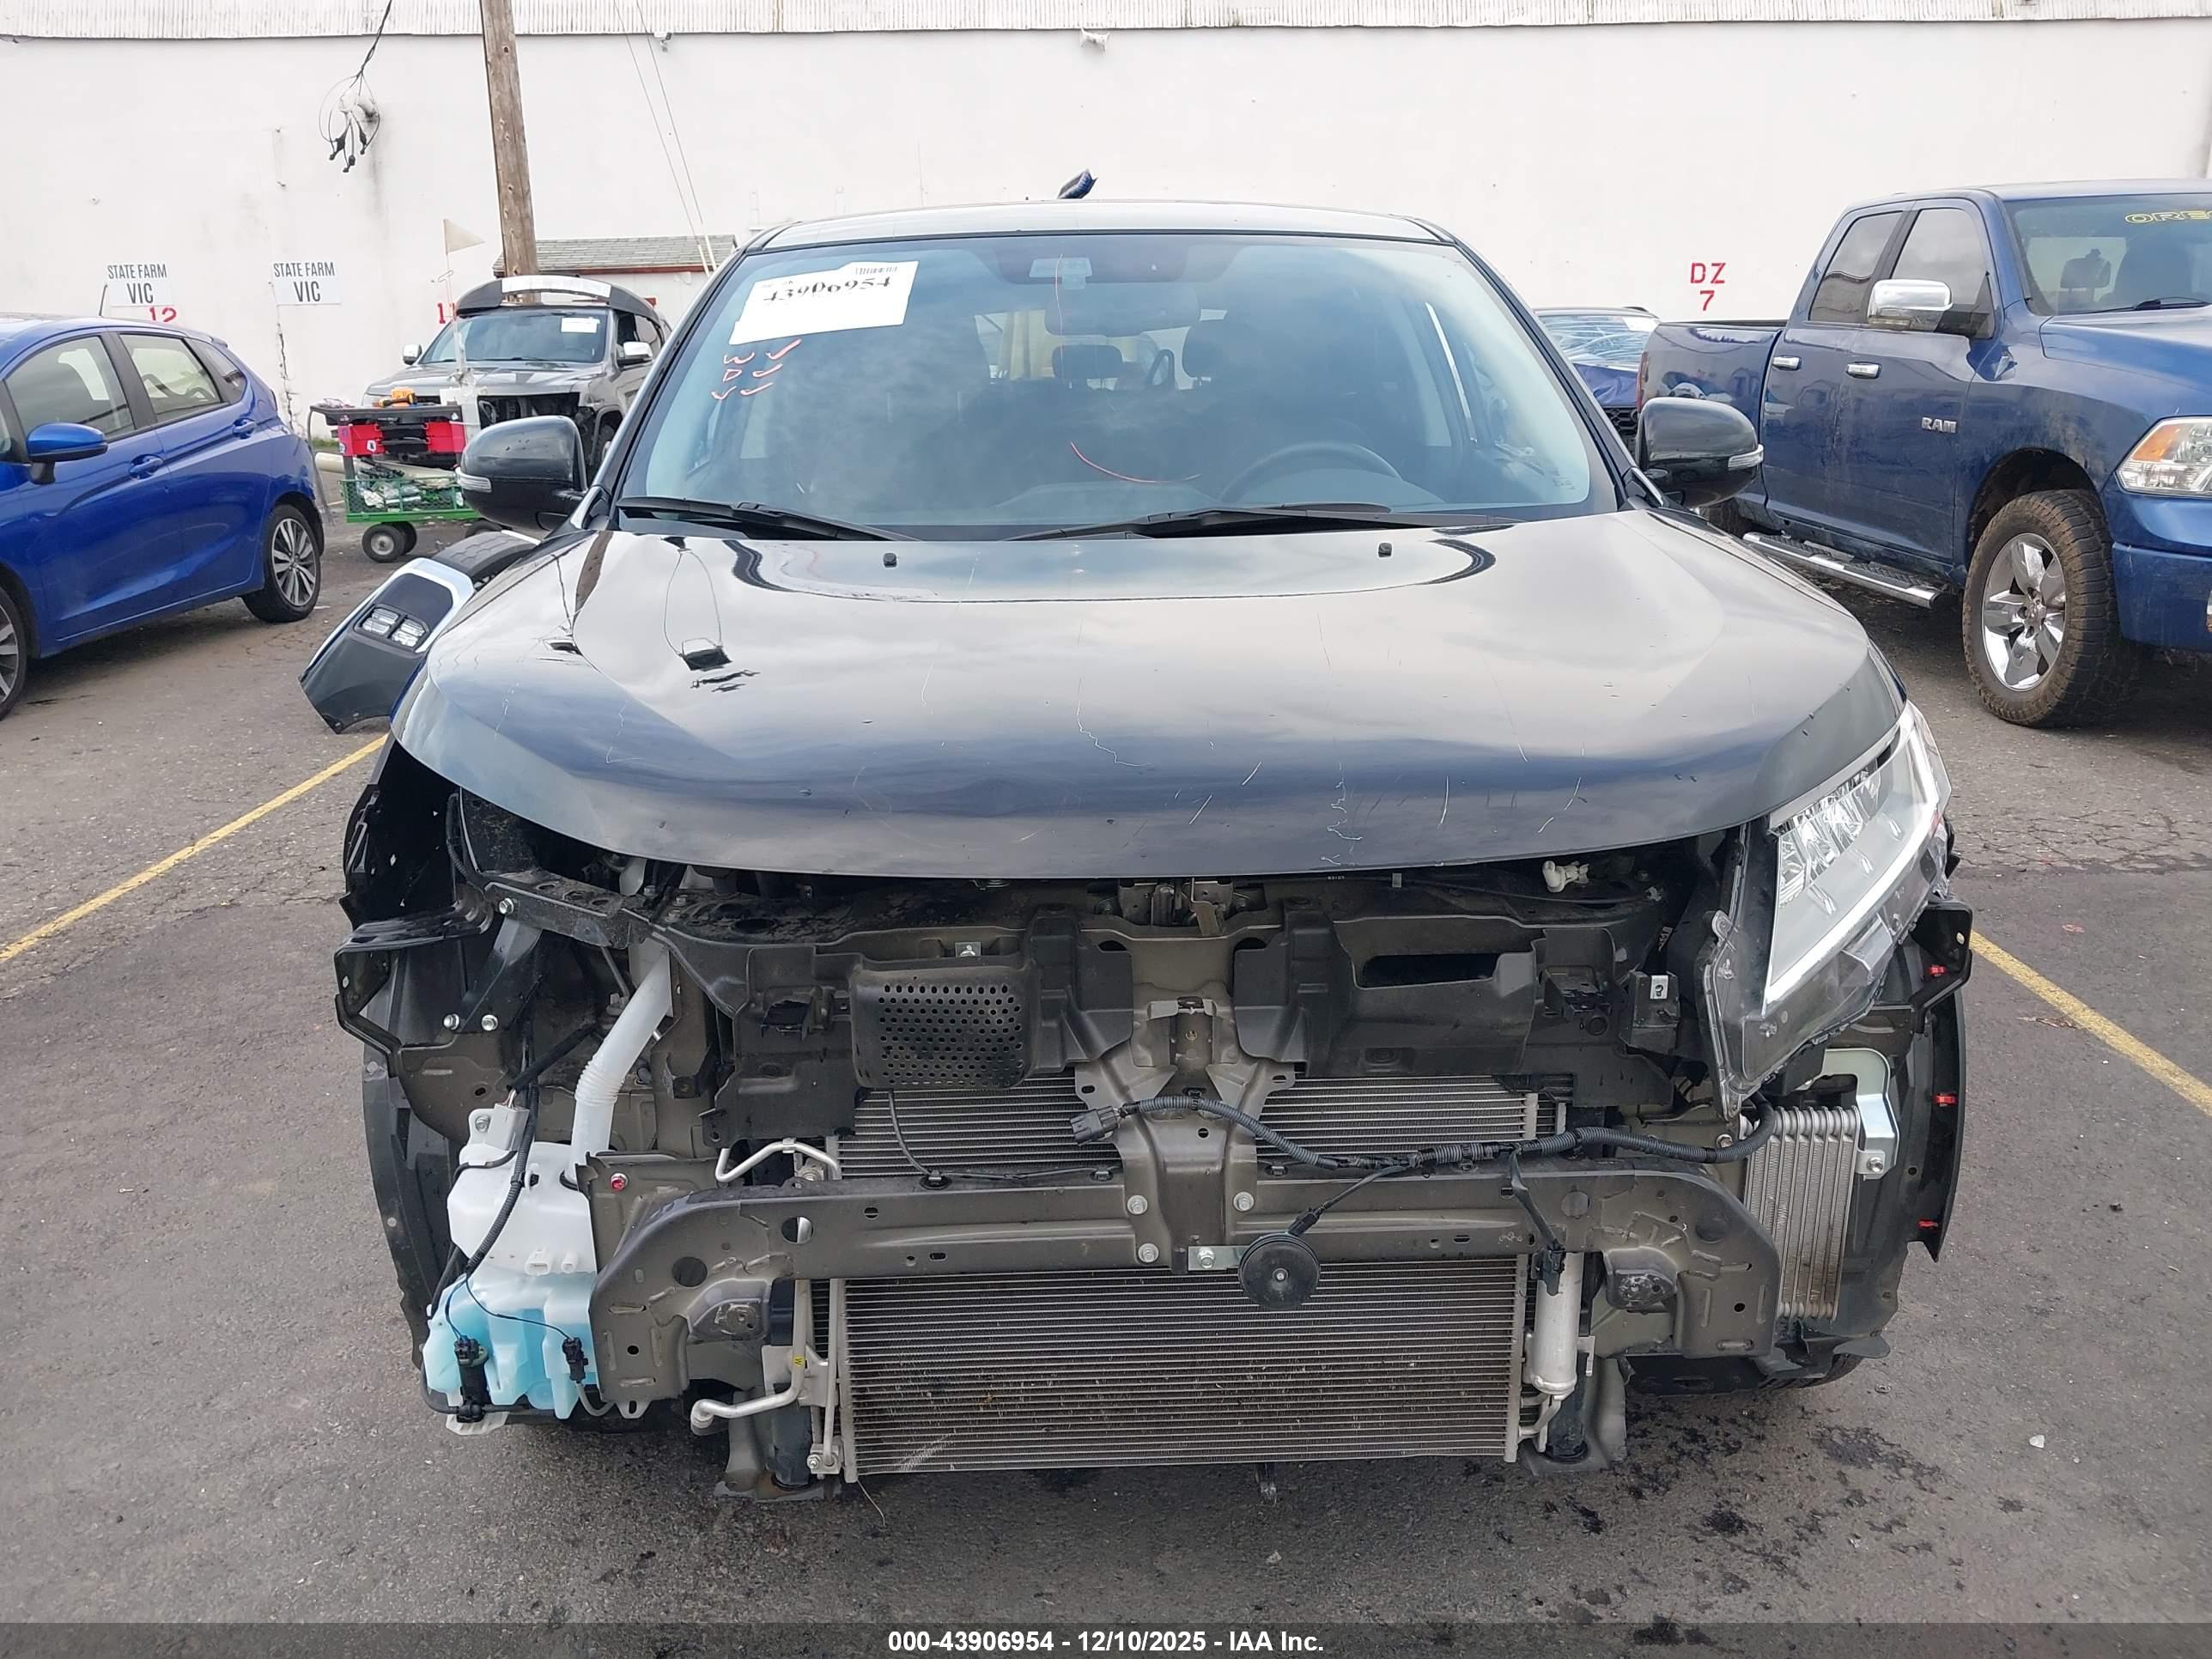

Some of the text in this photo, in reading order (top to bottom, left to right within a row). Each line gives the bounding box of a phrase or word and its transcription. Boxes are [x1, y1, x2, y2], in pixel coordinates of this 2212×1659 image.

[2124, 210, 2212, 223] ORE
[107, 264, 167, 279] STATE FARM
[273, 262, 335, 278] STATE FARM
[1690, 262, 1726, 284] DZ
[127, 283, 154, 304] VIC
[294, 281, 321, 302] VIC
[1700, 289, 1715, 311] 7
[149, 307, 177, 322] 12
[1921, 416, 1957, 434] RAM
